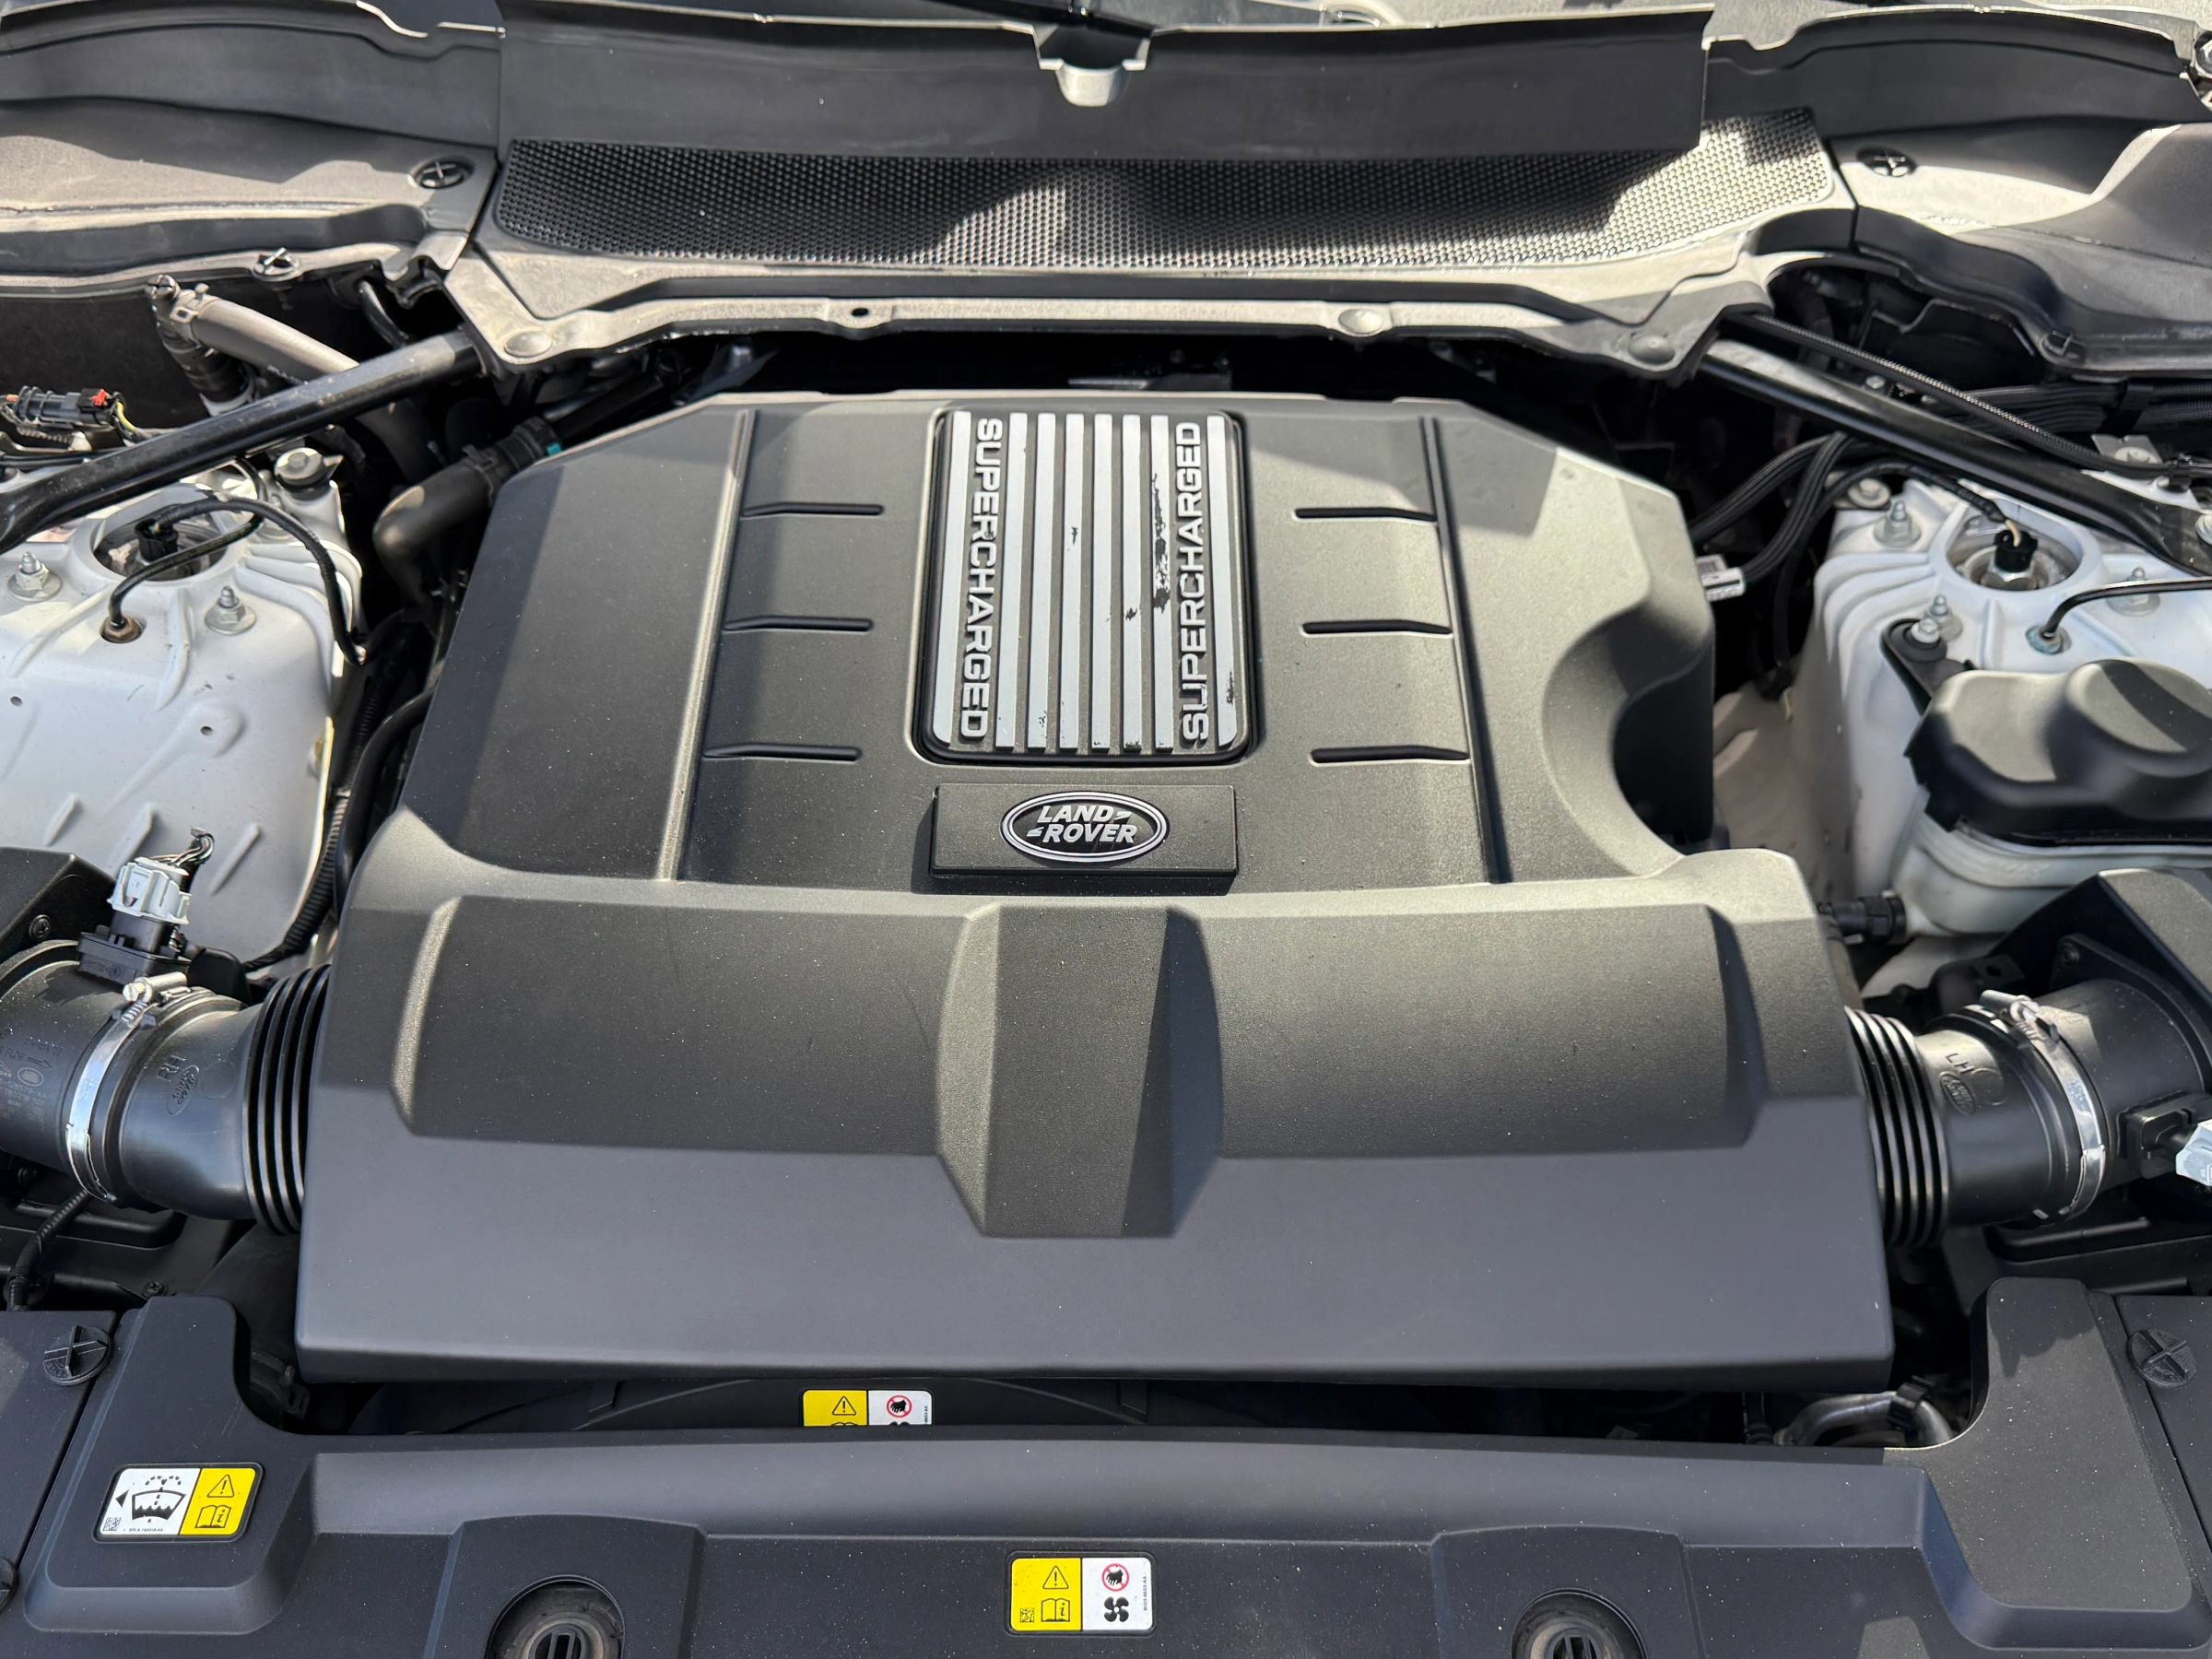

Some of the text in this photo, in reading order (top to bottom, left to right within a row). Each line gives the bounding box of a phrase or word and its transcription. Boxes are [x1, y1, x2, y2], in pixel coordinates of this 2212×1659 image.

[960, 418, 1003, 737] SUPERCHARGED
[1175, 421, 1208, 744] SUPERCHARGED
[156, 1054, 186, 1082] RH
[1945, 1053, 1975, 1075] LH
